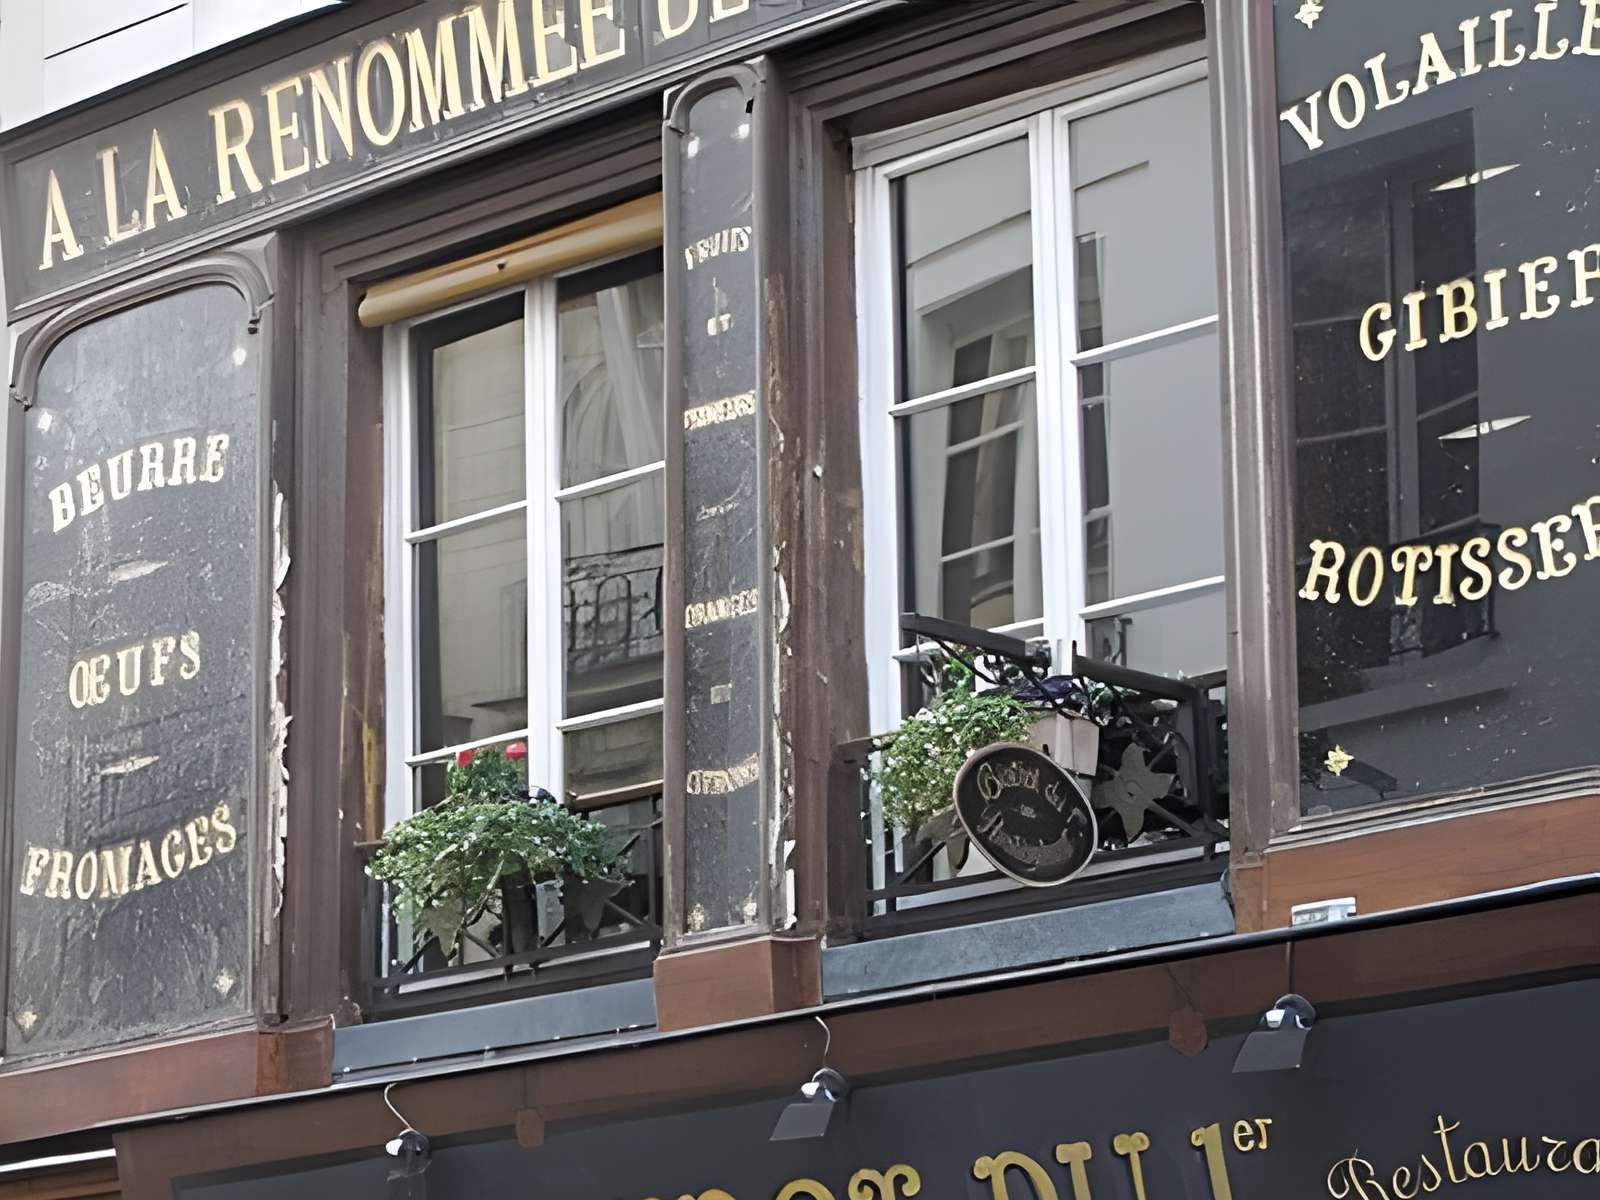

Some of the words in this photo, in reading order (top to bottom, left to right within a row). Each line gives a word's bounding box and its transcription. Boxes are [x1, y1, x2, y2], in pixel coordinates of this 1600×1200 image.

[38, 168, 85, 271] A
[96, 127, 188, 249] LA
[48, 432, 230, 533] BEURRE
[67, 629, 201, 709] ŒUFS
[19, 801, 238, 900] FROMAGES
